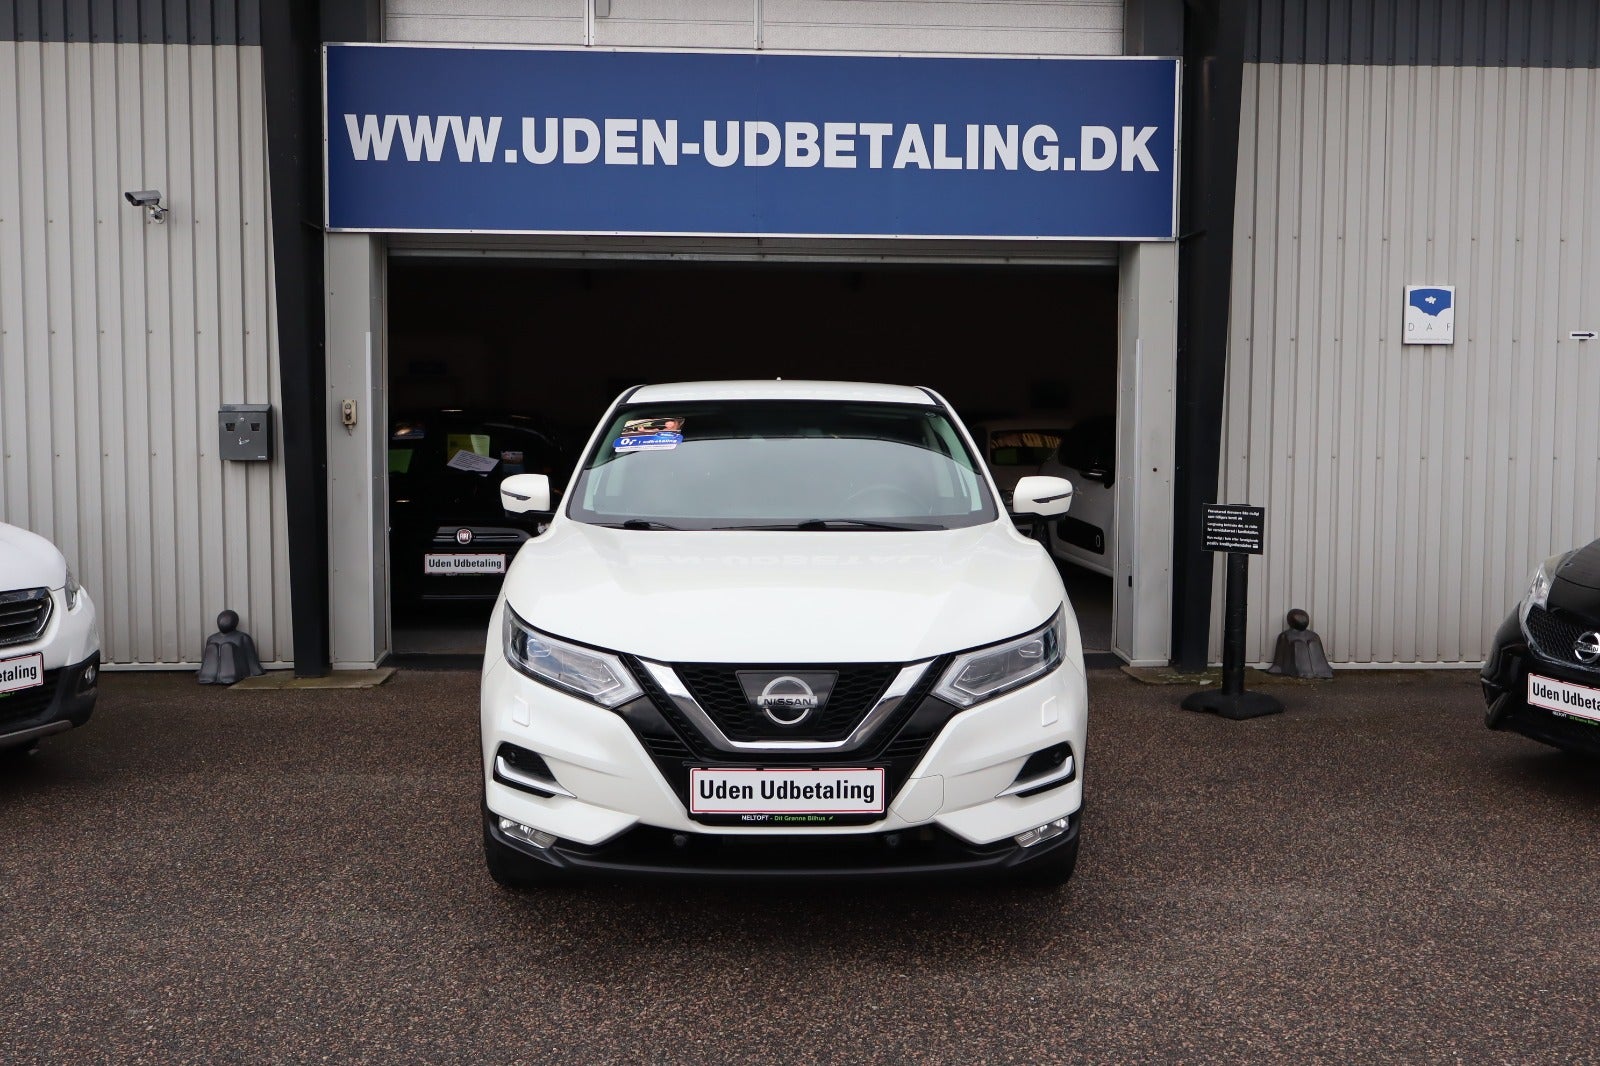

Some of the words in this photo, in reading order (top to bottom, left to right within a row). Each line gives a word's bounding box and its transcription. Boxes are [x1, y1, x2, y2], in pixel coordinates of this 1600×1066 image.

[344, 113, 1160, 172] WWW.UDEN-UDBETALING.DK
[428, 558, 452, 568] Uden
[453, 558, 502, 570] Udbetaling
[1532, 682, 1560, 701] Uden
[763, 698, 812, 706] NISSAN
[700, 780, 754, 800] Uden
[761, 780, 875, 803] Udbetaling
